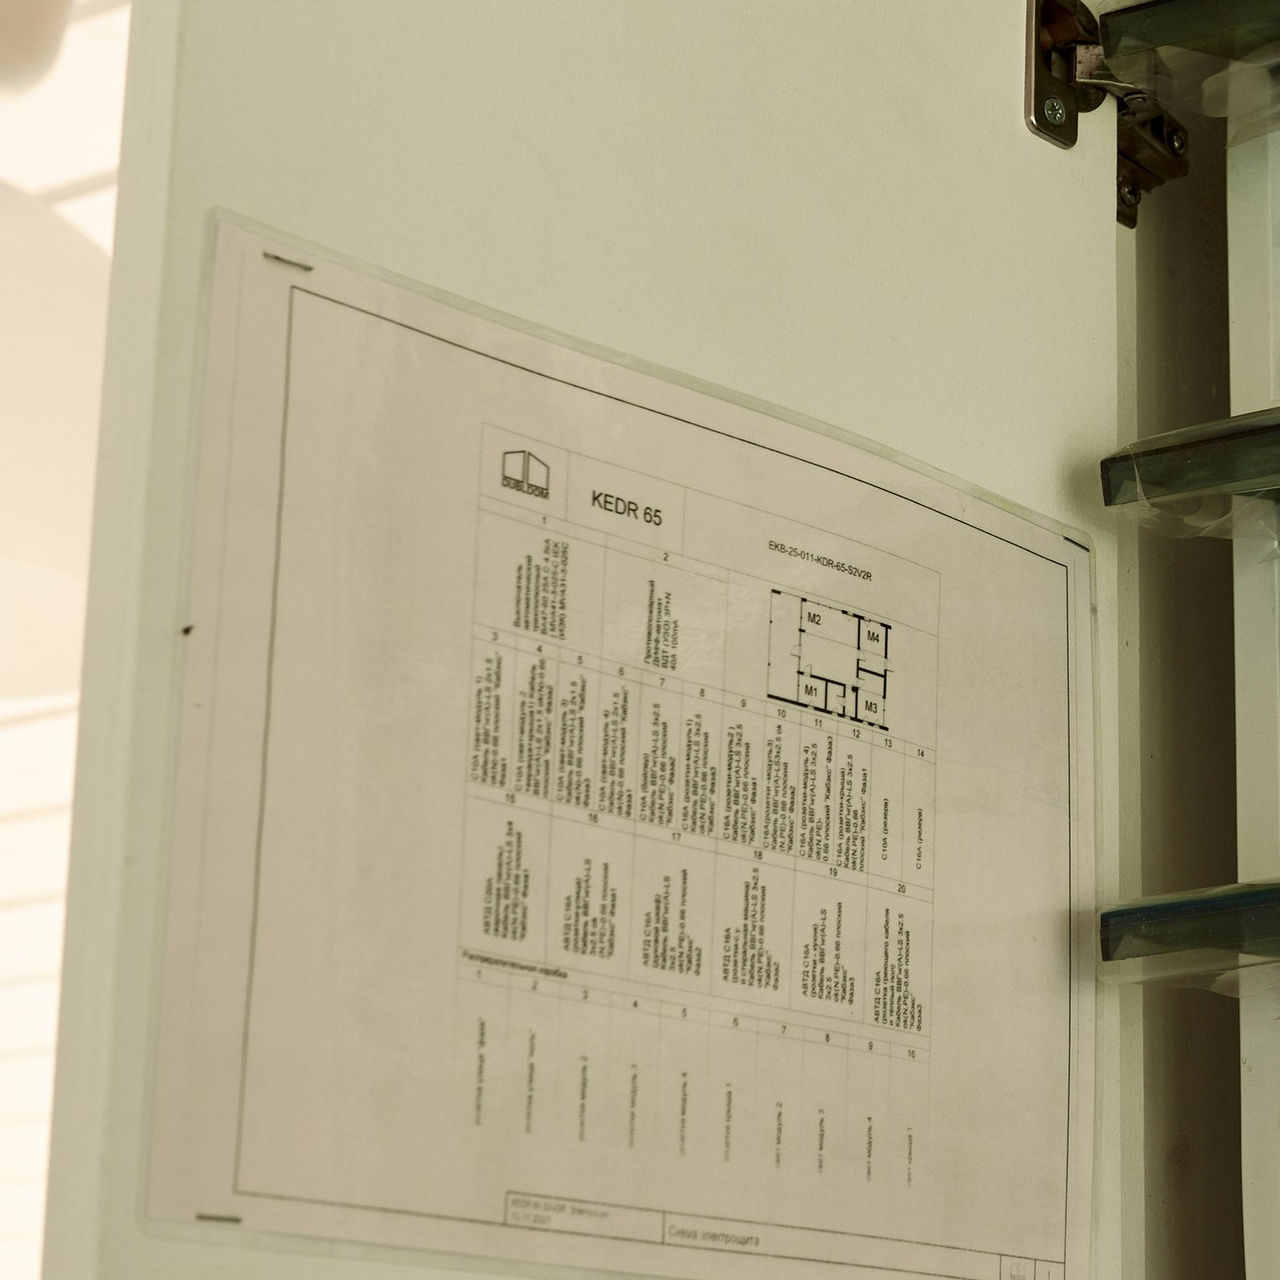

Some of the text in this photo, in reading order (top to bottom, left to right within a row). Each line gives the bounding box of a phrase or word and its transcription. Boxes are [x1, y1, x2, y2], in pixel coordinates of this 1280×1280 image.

[591, 490, 663, 526] KEDR 65
[807, 612, 821, 626] M2
[867, 630, 880, 644] M4
[804, 684, 818, 697] M1
[865, 700, 878, 714] M3
[777, 708, 787, 718] 10
[814, 718, 823, 728] 11
[852, 728, 860, 738] 12
[884, 738, 892, 748] 13
[917, 748, 924, 758] 14
[897, 883, 906, 894] 20
